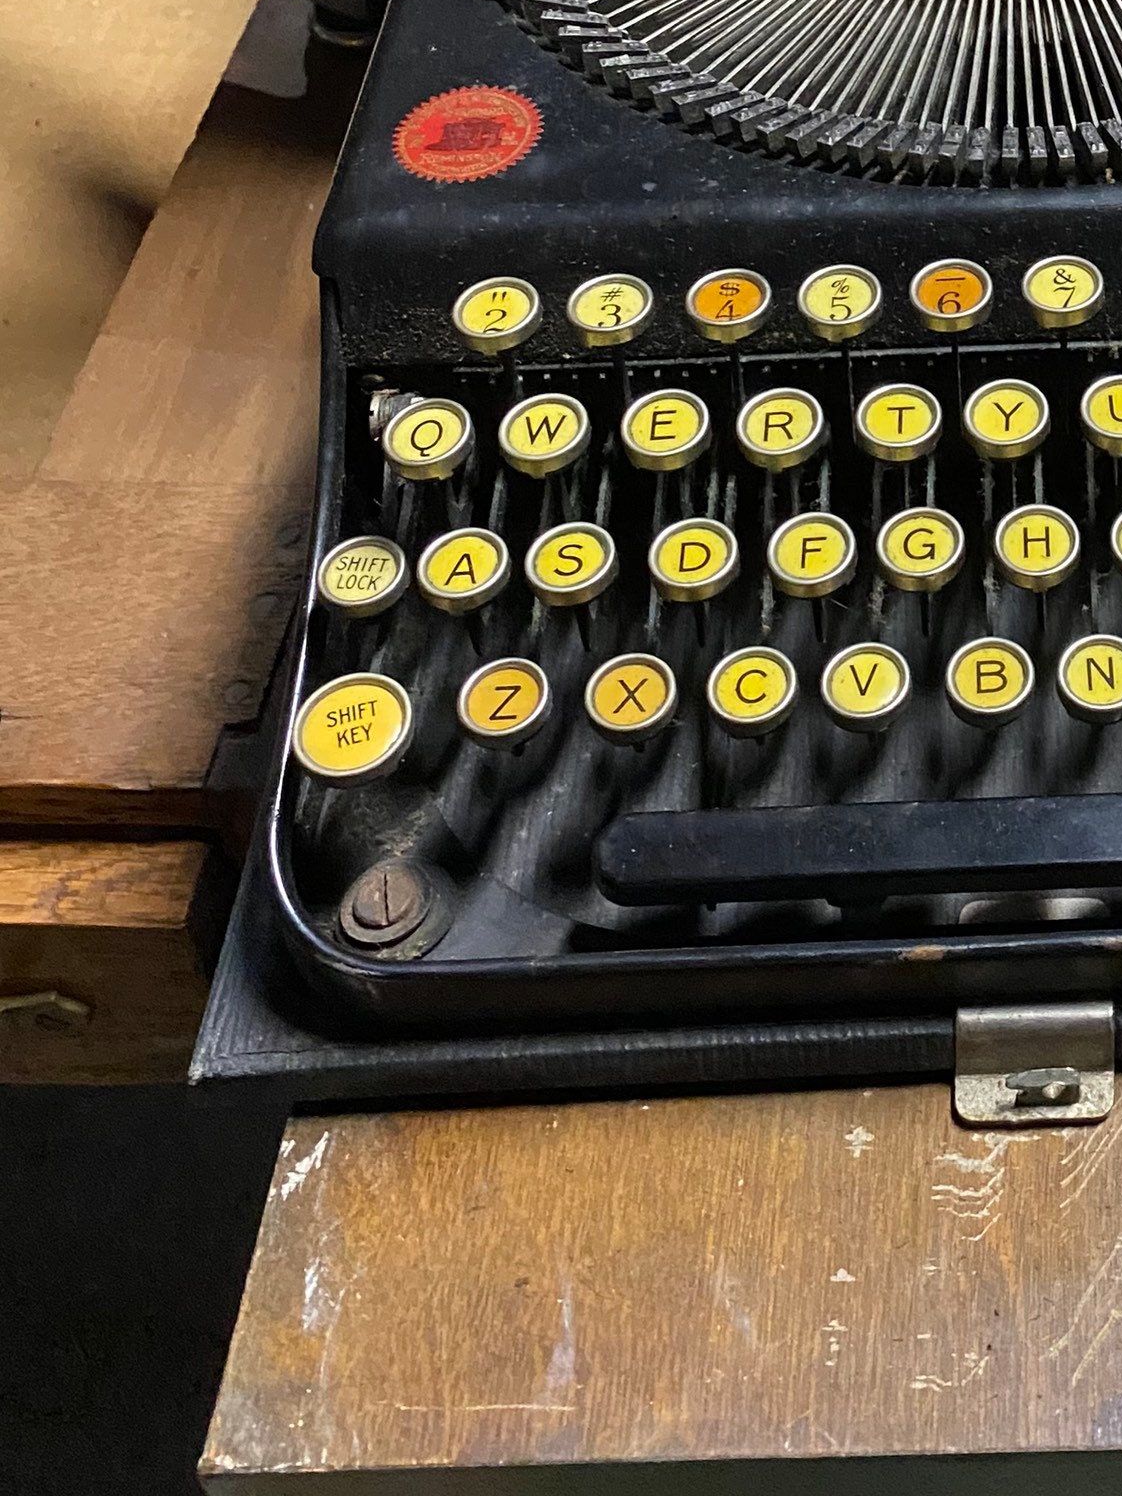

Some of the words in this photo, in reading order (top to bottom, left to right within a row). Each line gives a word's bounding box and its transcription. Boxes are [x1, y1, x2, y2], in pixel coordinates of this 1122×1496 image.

[719, 283, 741, 295] $
[831, 278, 850, 294] %
[1053, 269, 1077, 285] &
[600, 287, 624, 303] #
[830, 296, 851, 321] 5
[938, 292, 961, 314] 6
[1054, 285, 1076, 308] 7
[483, 309, 507, 333] 2
[598, 303, 621, 327] 3
[716, 300, 743, 322] 4
[525, 414, 567, 445] W
[649, 410, 677, 440] E
[764, 412, 794, 442] R
[887, 406, 916, 434] T
[992, 401, 1024, 432] Y
[411, 420, 443, 457] Q
[679, 542, 711, 572] D
[800, 536, 828, 568] F
[903, 528, 935, 560] G
[1023, 526, 1051, 559] H
[335, 556, 388, 572] SHIFT
[443, 552, 477, 586] A
[554, 544, 583, 576] S
[336, 573, 382, 591] LOCK
[735, 669, 767, 704] C
[849, 663, 879, 697] V
[976, 660, 1008, 694] B
[1087, 656, 1116, 692] N
[489, 686, 522, 720] Z
[612, 679, 649, 714] X
[326, 699, 378, 728] SHIFT
[336, 723, 373, 749] KEY
